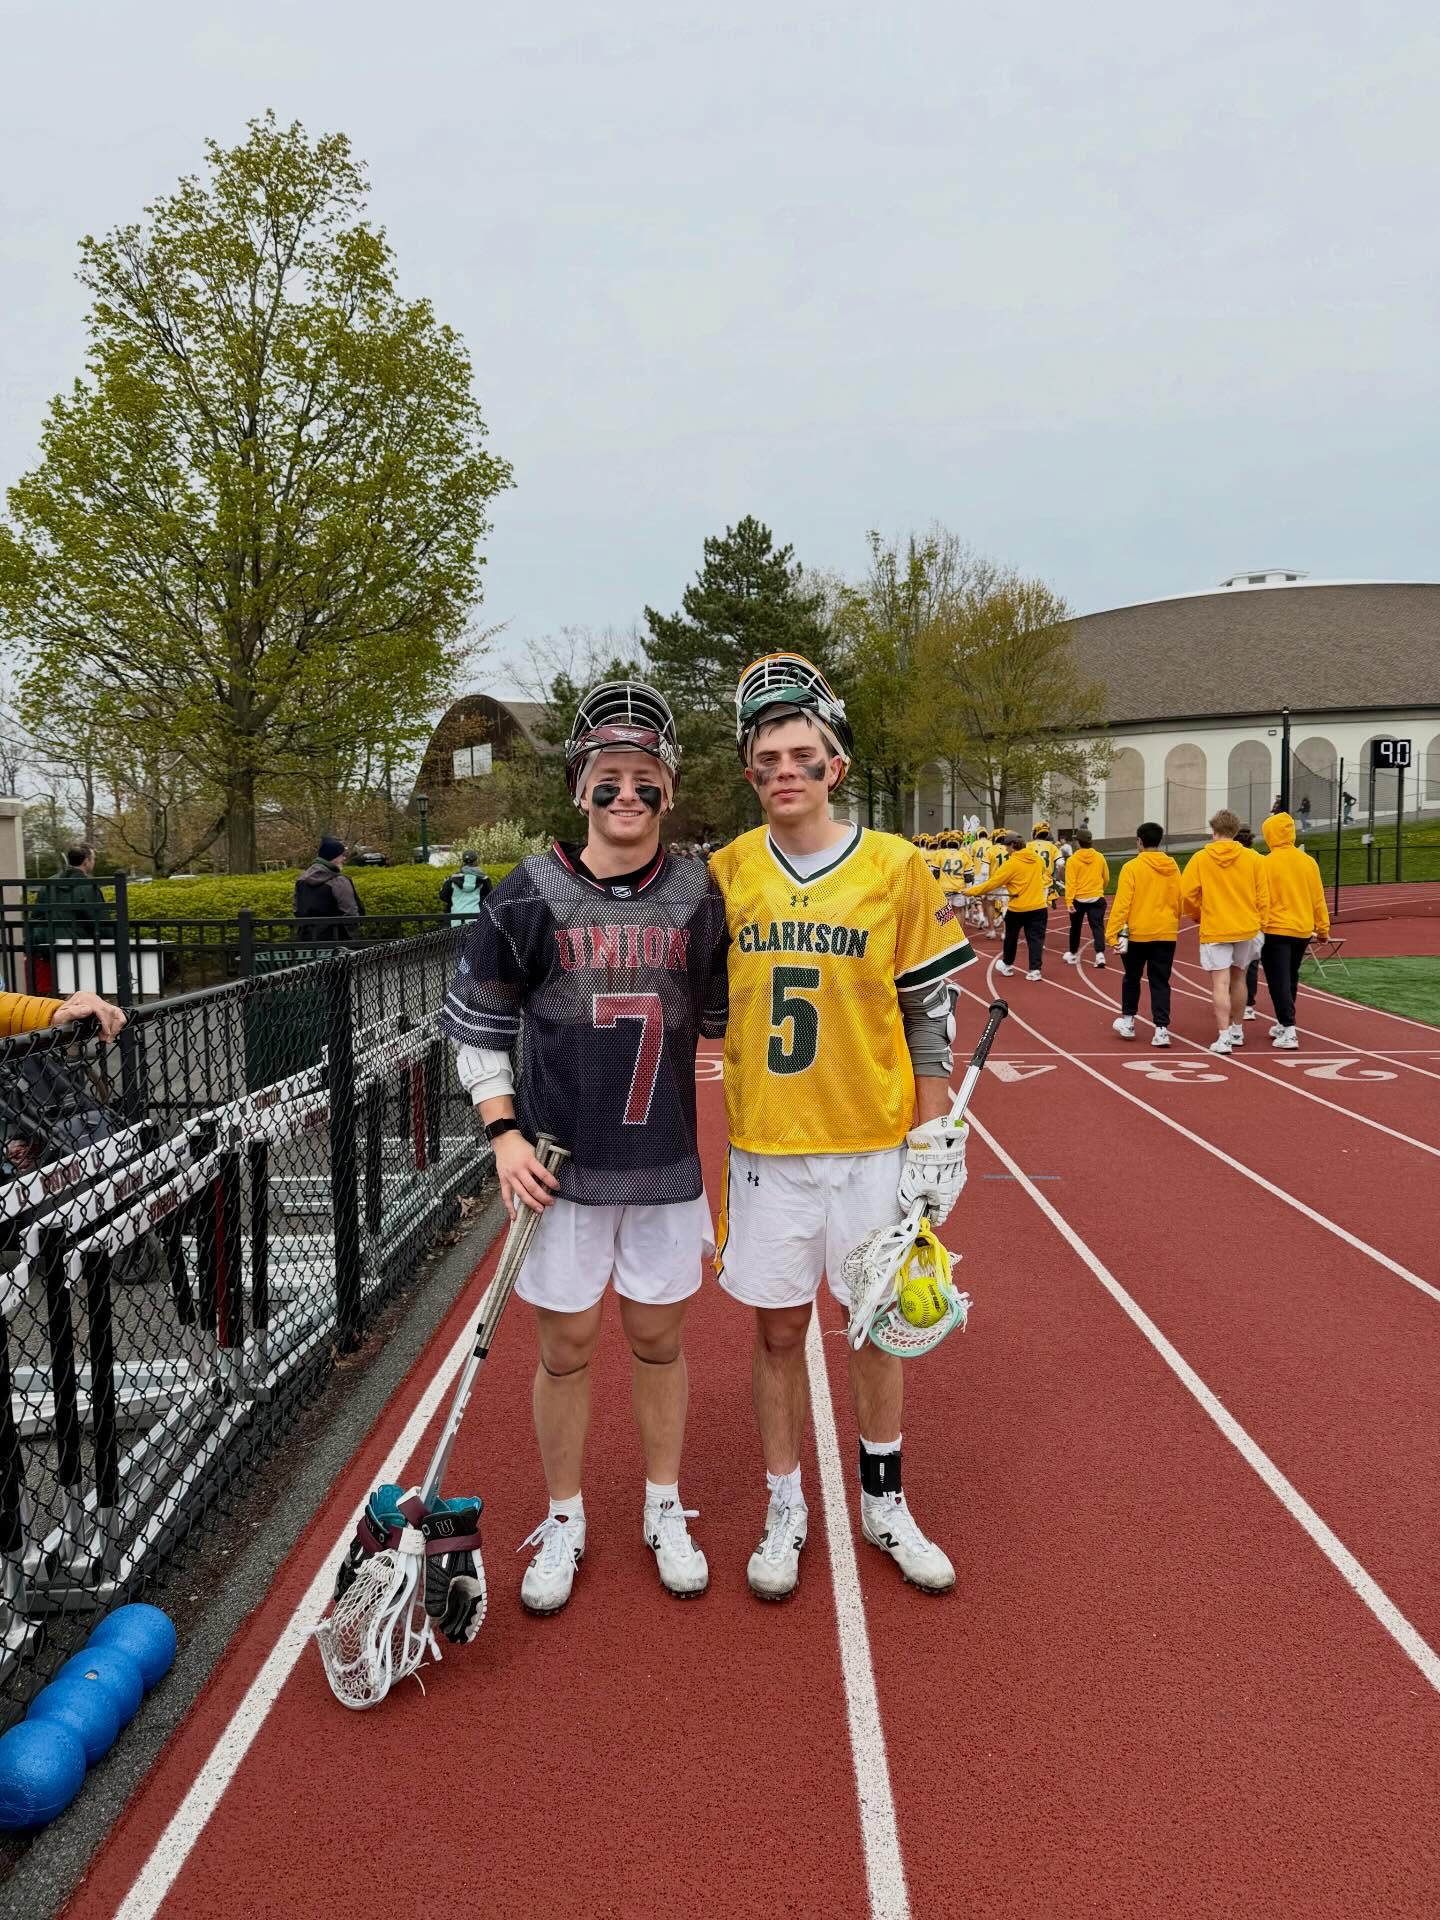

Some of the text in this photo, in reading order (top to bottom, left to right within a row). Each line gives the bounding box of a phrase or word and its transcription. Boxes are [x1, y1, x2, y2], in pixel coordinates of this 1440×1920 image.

[943, 858, 963, 875] 42
[555, 925, 690, 971] UNION
[738, 920, 869, 959] CLARKSON
[767, 964, 821, 1076] 5
[593, 992, 664, 1125] 7
[1122, 1060, 1229, 1083] 3
[1272, 1058, 1399, 1081] 2
